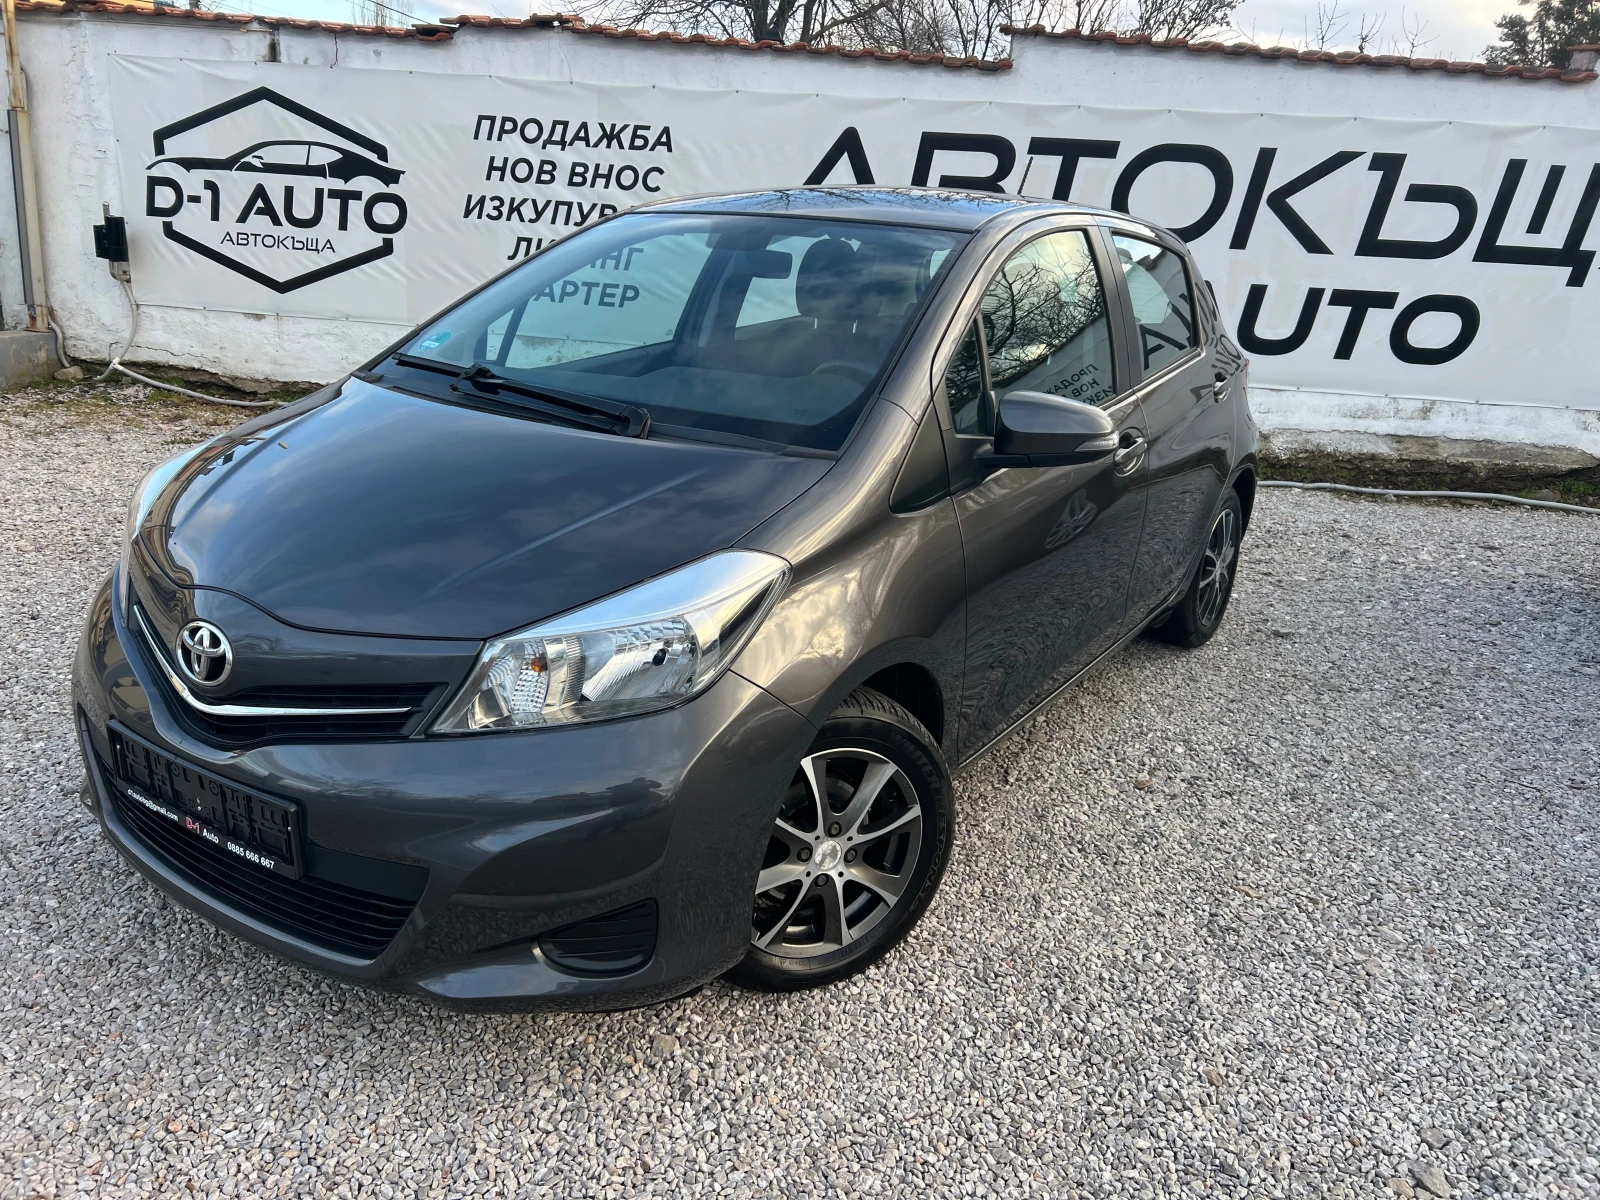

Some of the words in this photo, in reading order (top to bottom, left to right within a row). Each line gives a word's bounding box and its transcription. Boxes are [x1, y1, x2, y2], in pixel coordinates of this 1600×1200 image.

[473, 114, 673, 153] ПРОДАЖБА
[485, 155, 558, 185] НОВ
[567, 161, 665, 193] ВНОС
[145, 175, 221, 222] D-1
[235, 182, 408, 235] AUTO
[462, 193, 636, 228] ИЗКУПУВ
[802, 126, 1600, 288] АВТОКЪЩ
[220, 231, 336, 255] АВТОКЪЩА
[532, 280, 640, 308] АРТЕР
[1205, 280, 1481, 366] UTO
[185, 816, 200, 834] D-1
[202, 828, 219, 845] Auto
[227, 841, 245, 858] 0885
[245, 850, 260, 864] 666
[260, 856, 276, 870] 667
